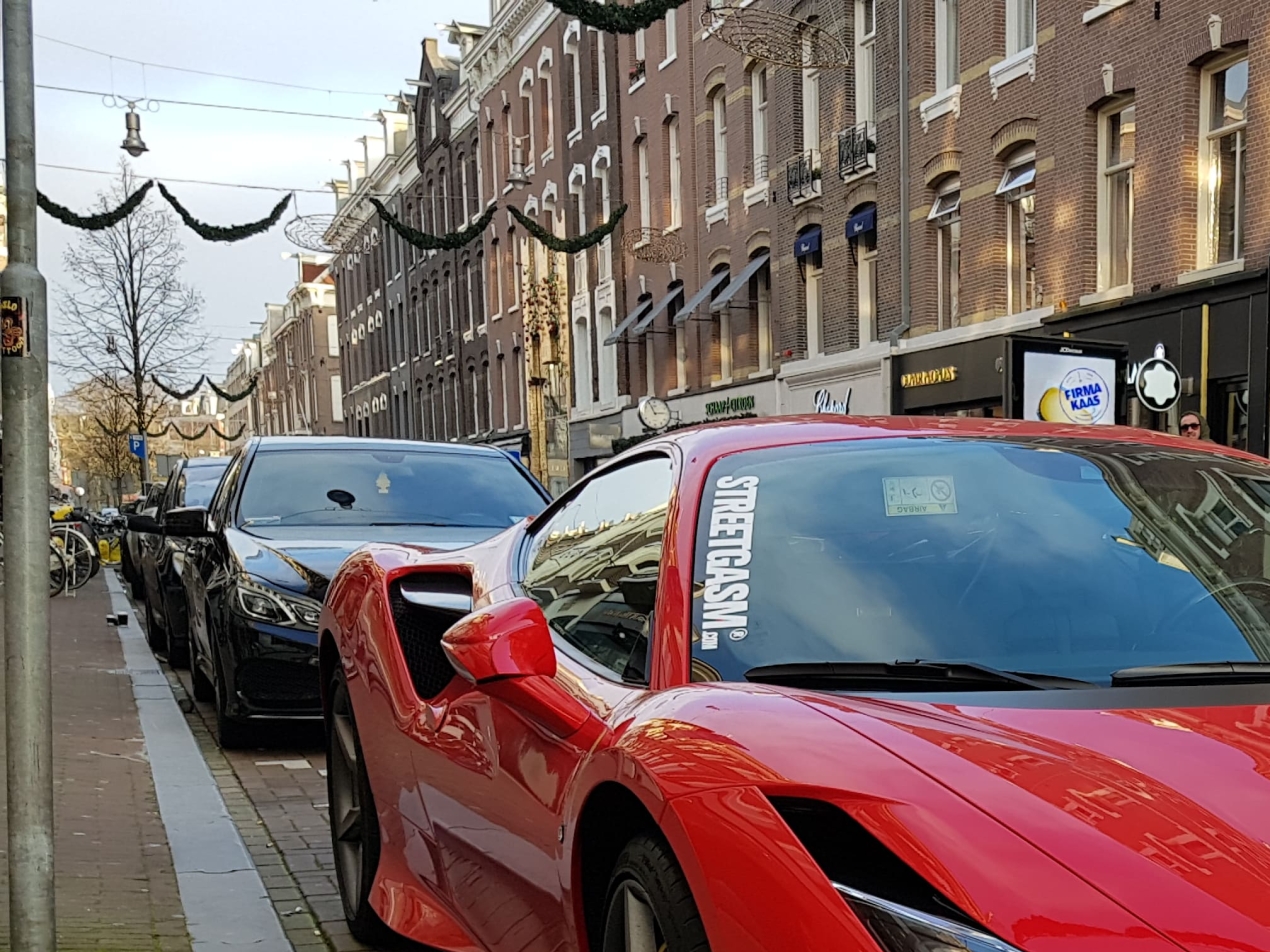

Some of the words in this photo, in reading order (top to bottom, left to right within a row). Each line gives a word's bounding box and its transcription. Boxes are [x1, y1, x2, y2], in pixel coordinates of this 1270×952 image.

[1065, 382, 1102, 401] FIRMA
[1070, 395, 1101, 412] KAAS
[133, 440, 141, 451] P
[896, 505, 927, 513] AIRBAG
